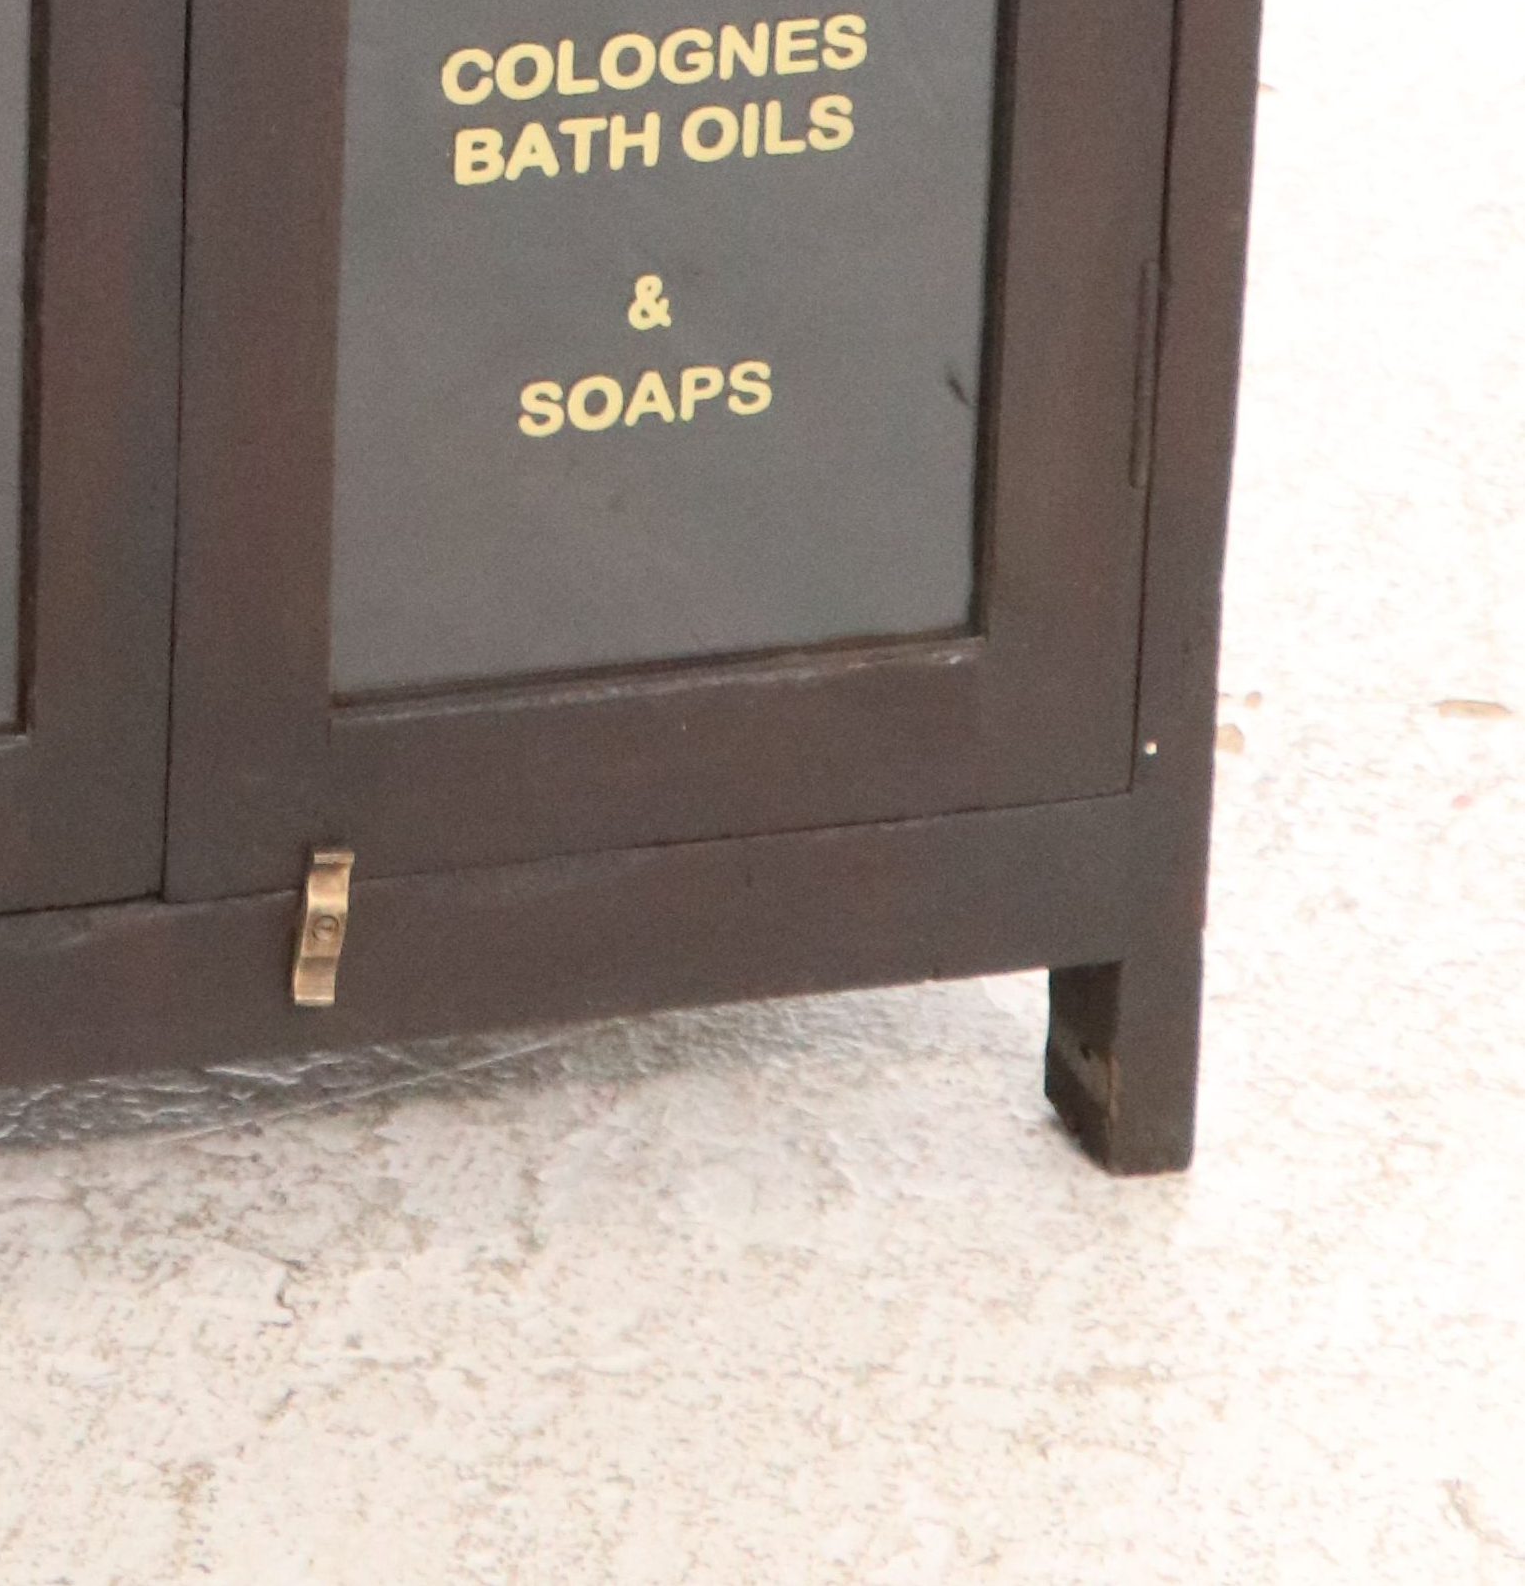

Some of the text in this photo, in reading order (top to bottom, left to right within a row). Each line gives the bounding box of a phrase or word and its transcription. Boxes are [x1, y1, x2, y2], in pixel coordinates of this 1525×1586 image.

[439, 11, 869, 106] COLOGNES
[452, 91, 856, 187] BATH OILS
[625, 272, 674, 331] &
[516, 358, 774, 439] SOAPS
